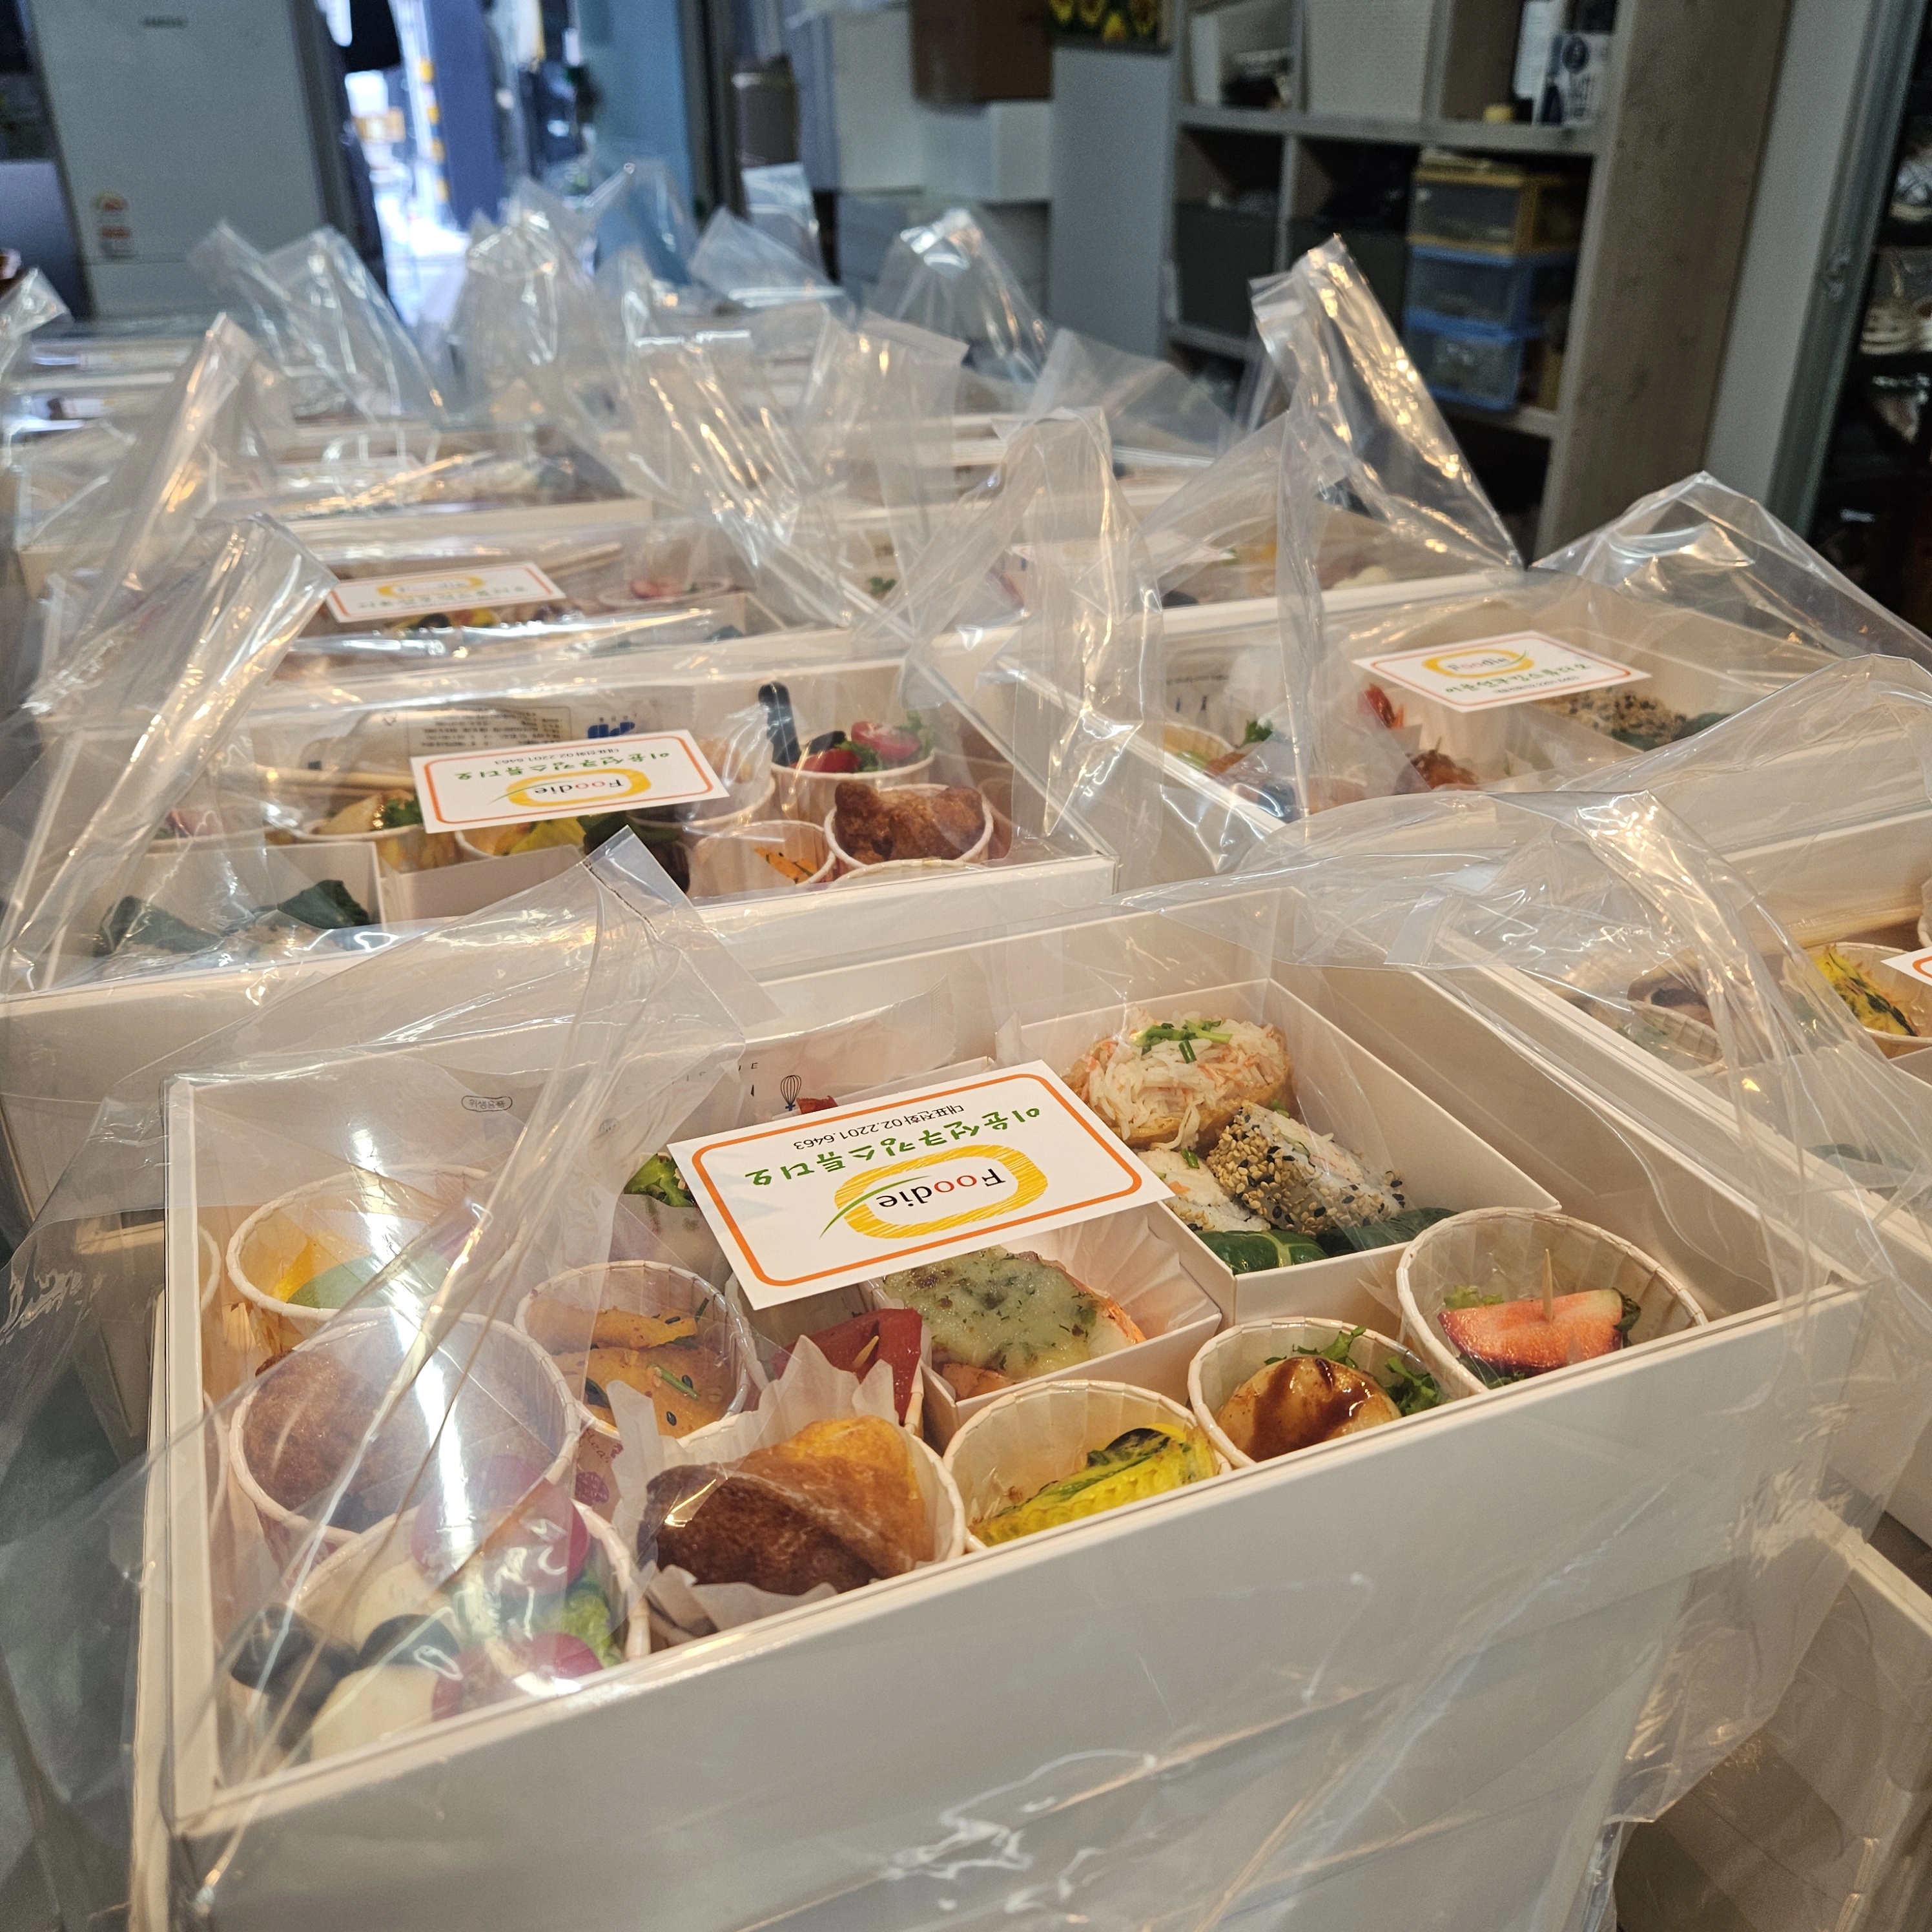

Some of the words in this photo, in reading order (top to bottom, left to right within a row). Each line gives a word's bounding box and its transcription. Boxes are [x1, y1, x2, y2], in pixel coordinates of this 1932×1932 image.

[534, 779, 624, 795] Foodie
[903, 1104, 965, 1125] 대표전화
[745, 1107, 1040, 1186] 이윤선쿠킹스튜디오
[793, 1118, 903, 1150] 02.2201.6463
[876, 1168, 1006, 1209] Foodie
